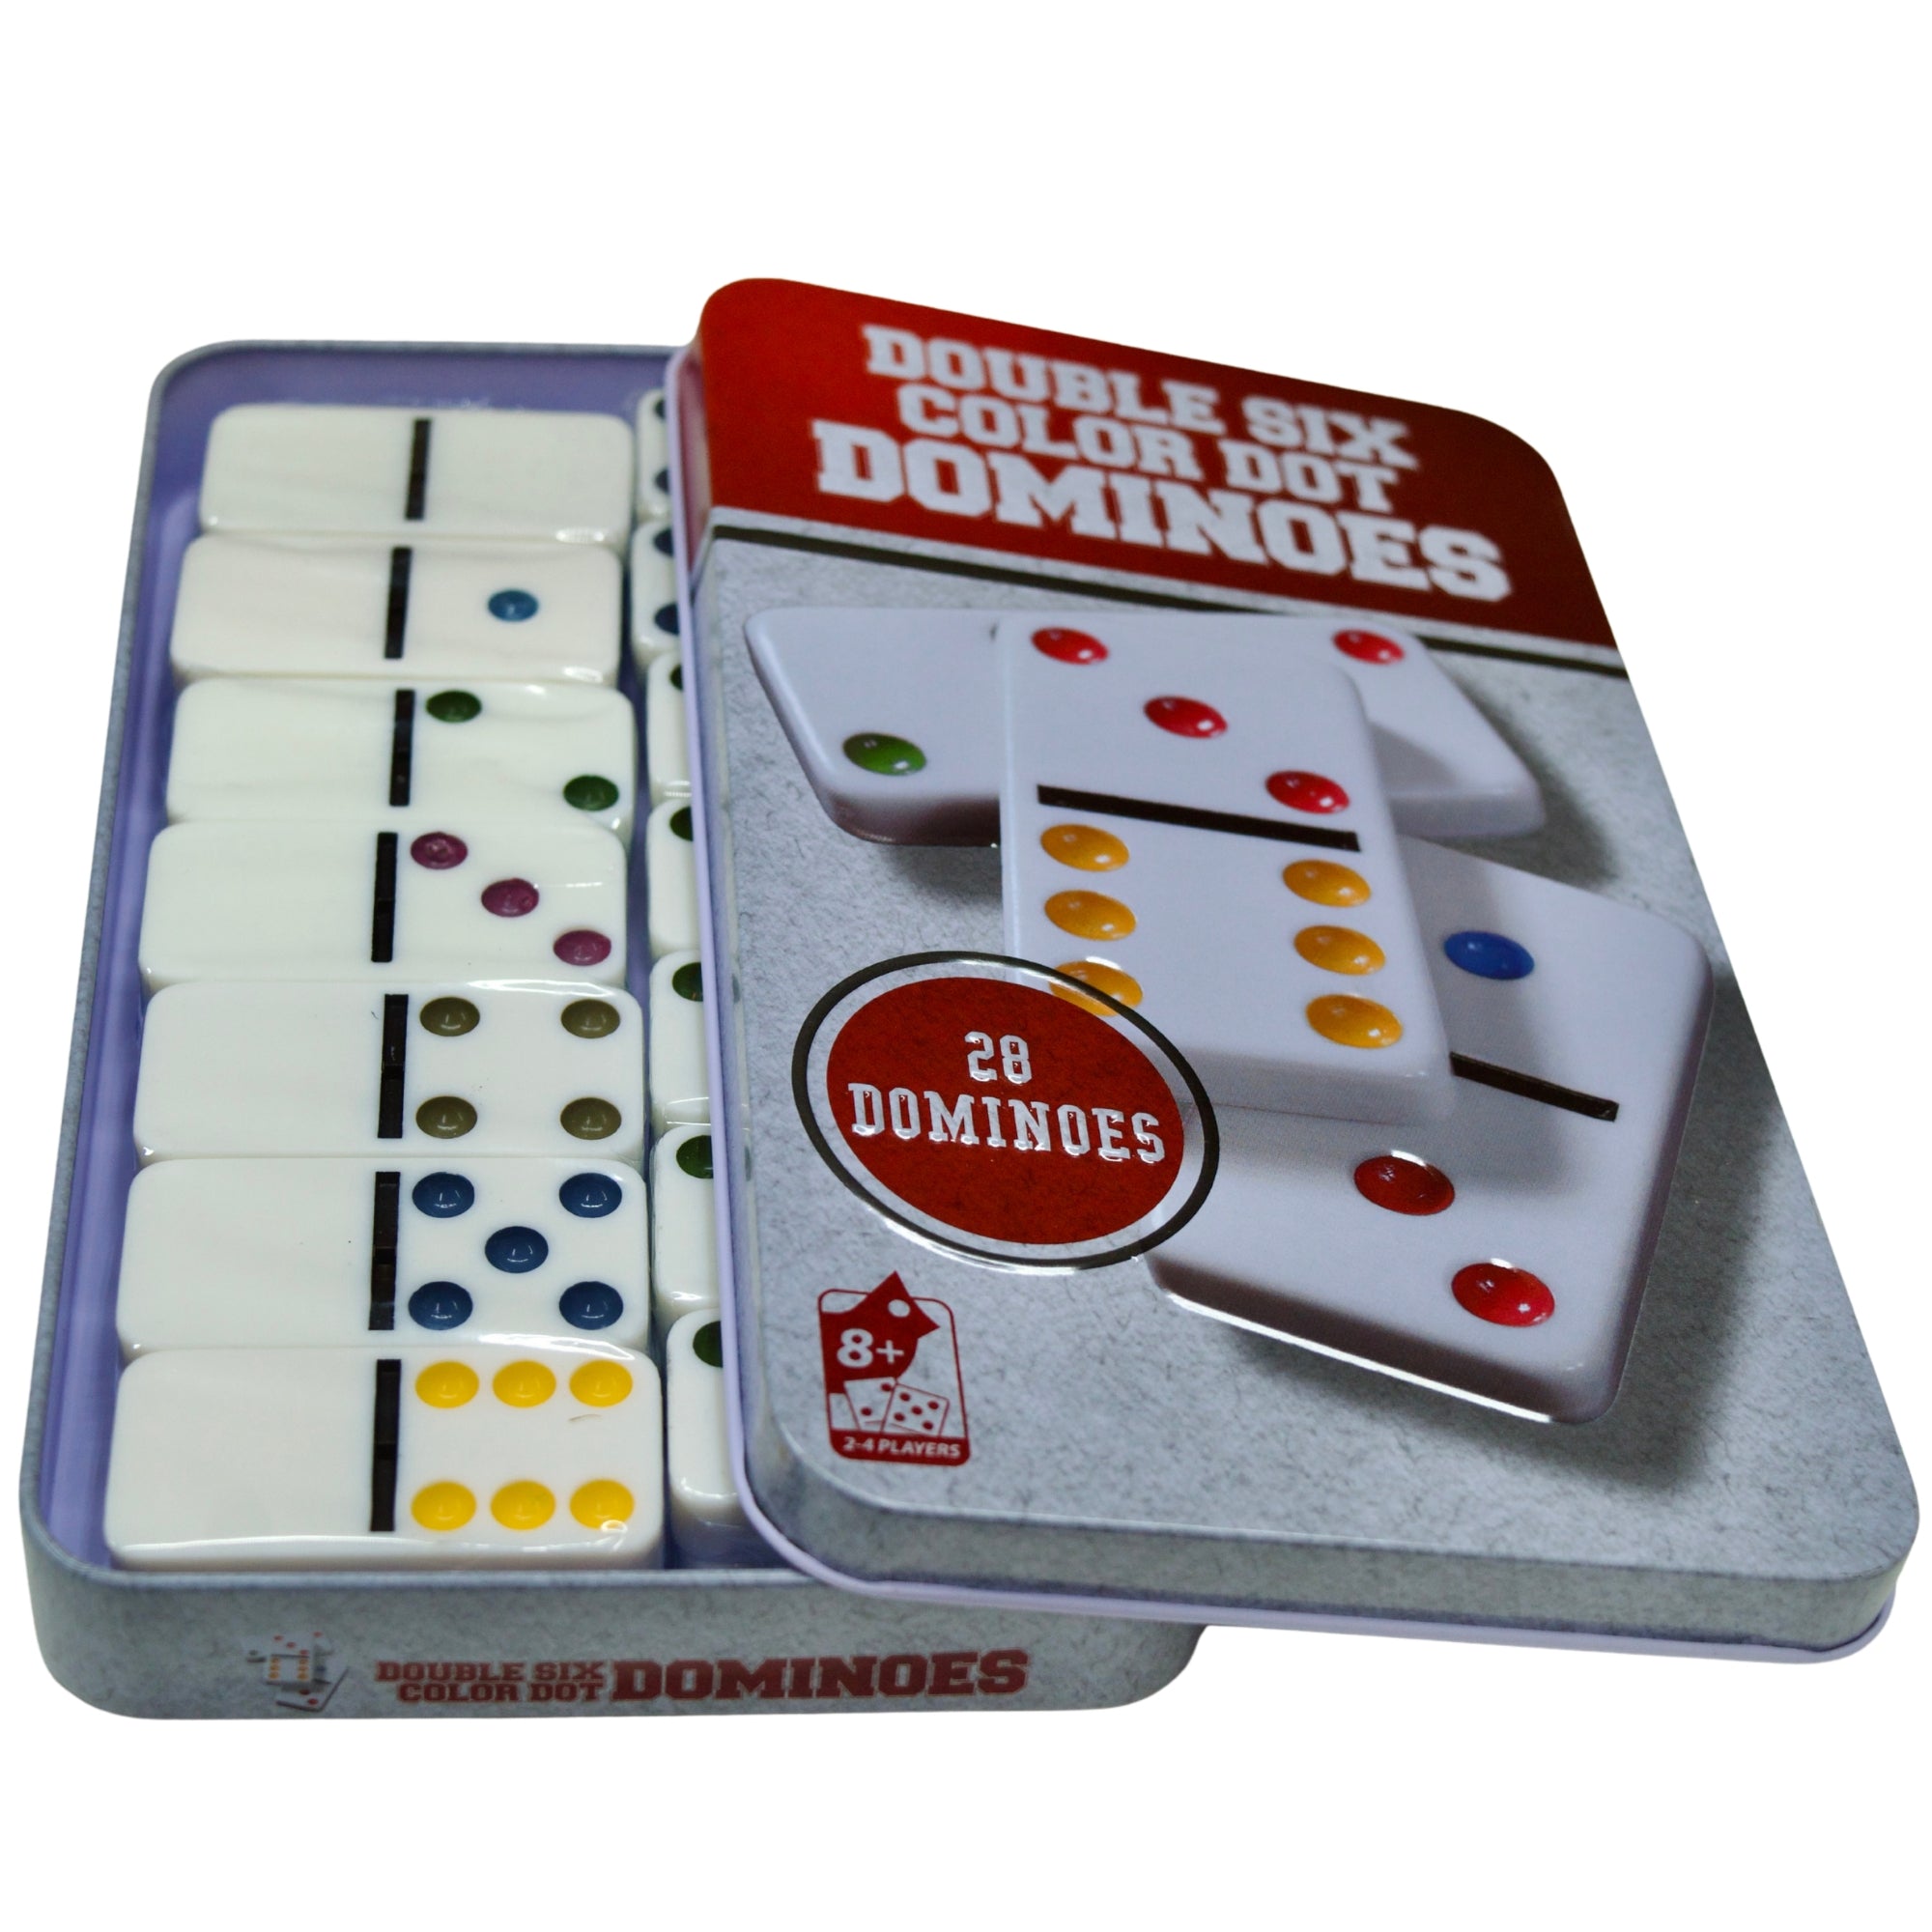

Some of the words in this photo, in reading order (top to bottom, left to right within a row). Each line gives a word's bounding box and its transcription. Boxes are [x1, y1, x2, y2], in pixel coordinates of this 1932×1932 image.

[863, 324, 1227, 436] DOUBLE
[1241, 395, 1419, 469] SIX
[897, 383, 1203, 481] COLOR
[1218, 439, 1399, 513] DOT
[811, 419, 1512, 602] DOMINOES
[964, 1031, 1033, 1084] 28
[848, 1082, 1166, 1165] DOMINOES
[837, 1328, 905, 1370] 8+
[842, 1436, 875, 1453] 2-4
[877, 1437, 961, 1459] PLAYERS
[375, 1661, 526, 1682] DOUBLE
[534, 1661, 604, 1682] SIX
[397, 1683, 522, 1702] COLOR
[526, 1682, 605, 1702] DOT
[611, 1648, 1029, 1701] DOMINOES
